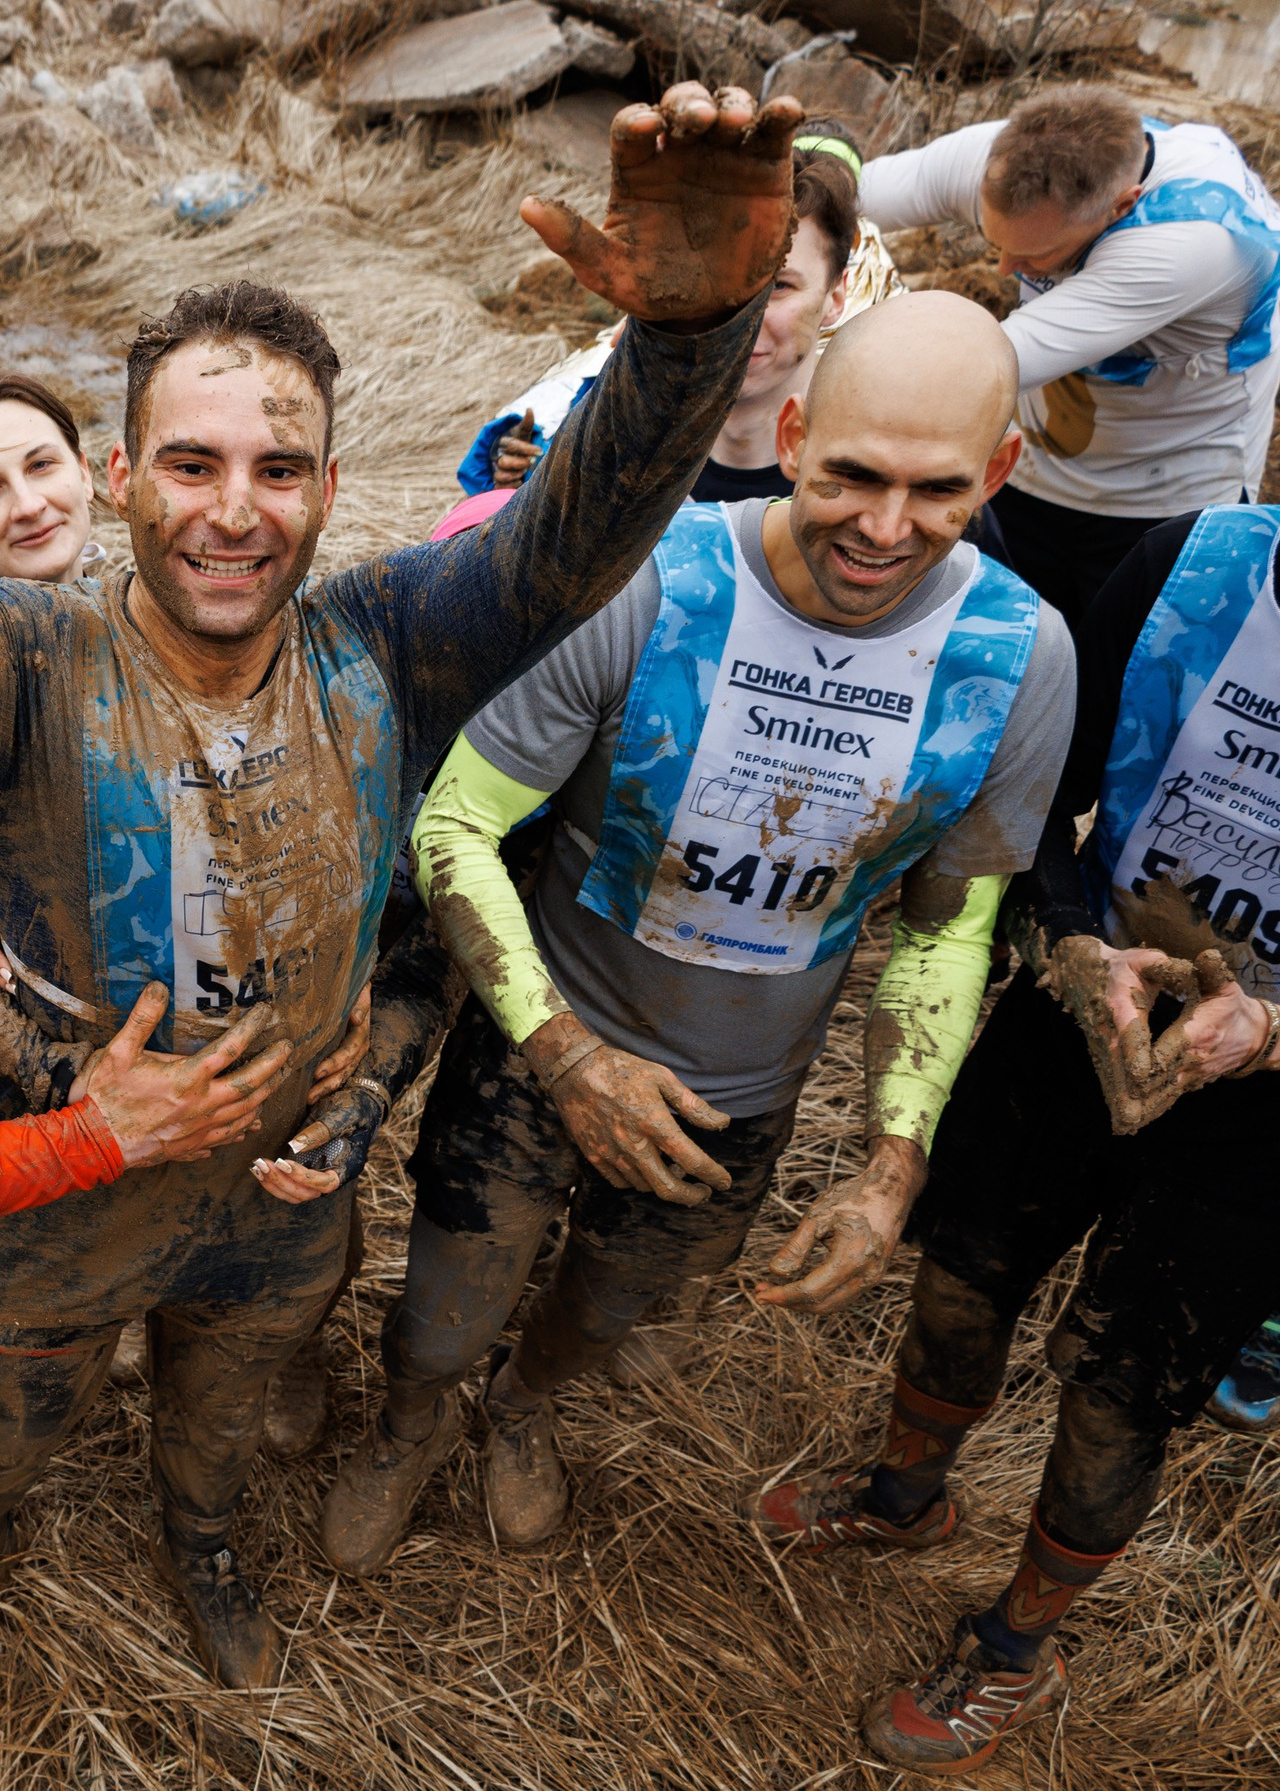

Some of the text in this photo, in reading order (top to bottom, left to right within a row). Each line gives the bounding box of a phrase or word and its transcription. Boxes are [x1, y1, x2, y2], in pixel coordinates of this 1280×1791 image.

[730, 659, 915, 715] ГОНКА ГЕРОЕВ
[1217, 680, 1280, 724] ГОНК
[743, 705, 875, 759] Sminex
[735, 751, 865, 787] ПЕРФЕКЦИОНИСТЫ
[1213, 729, 1280, 780] Sm
[729, 766, 860, 802] FINE DEVELOPMENT
[1192, 785, 1226, 804] FINE
[1146, 769, 1280, 874] Васил
[205, 873, 235, 890] FINE
[677, 839, 839, 913] 5410
[700, 932, 790, 956] ГАЗПРОМБАНК
